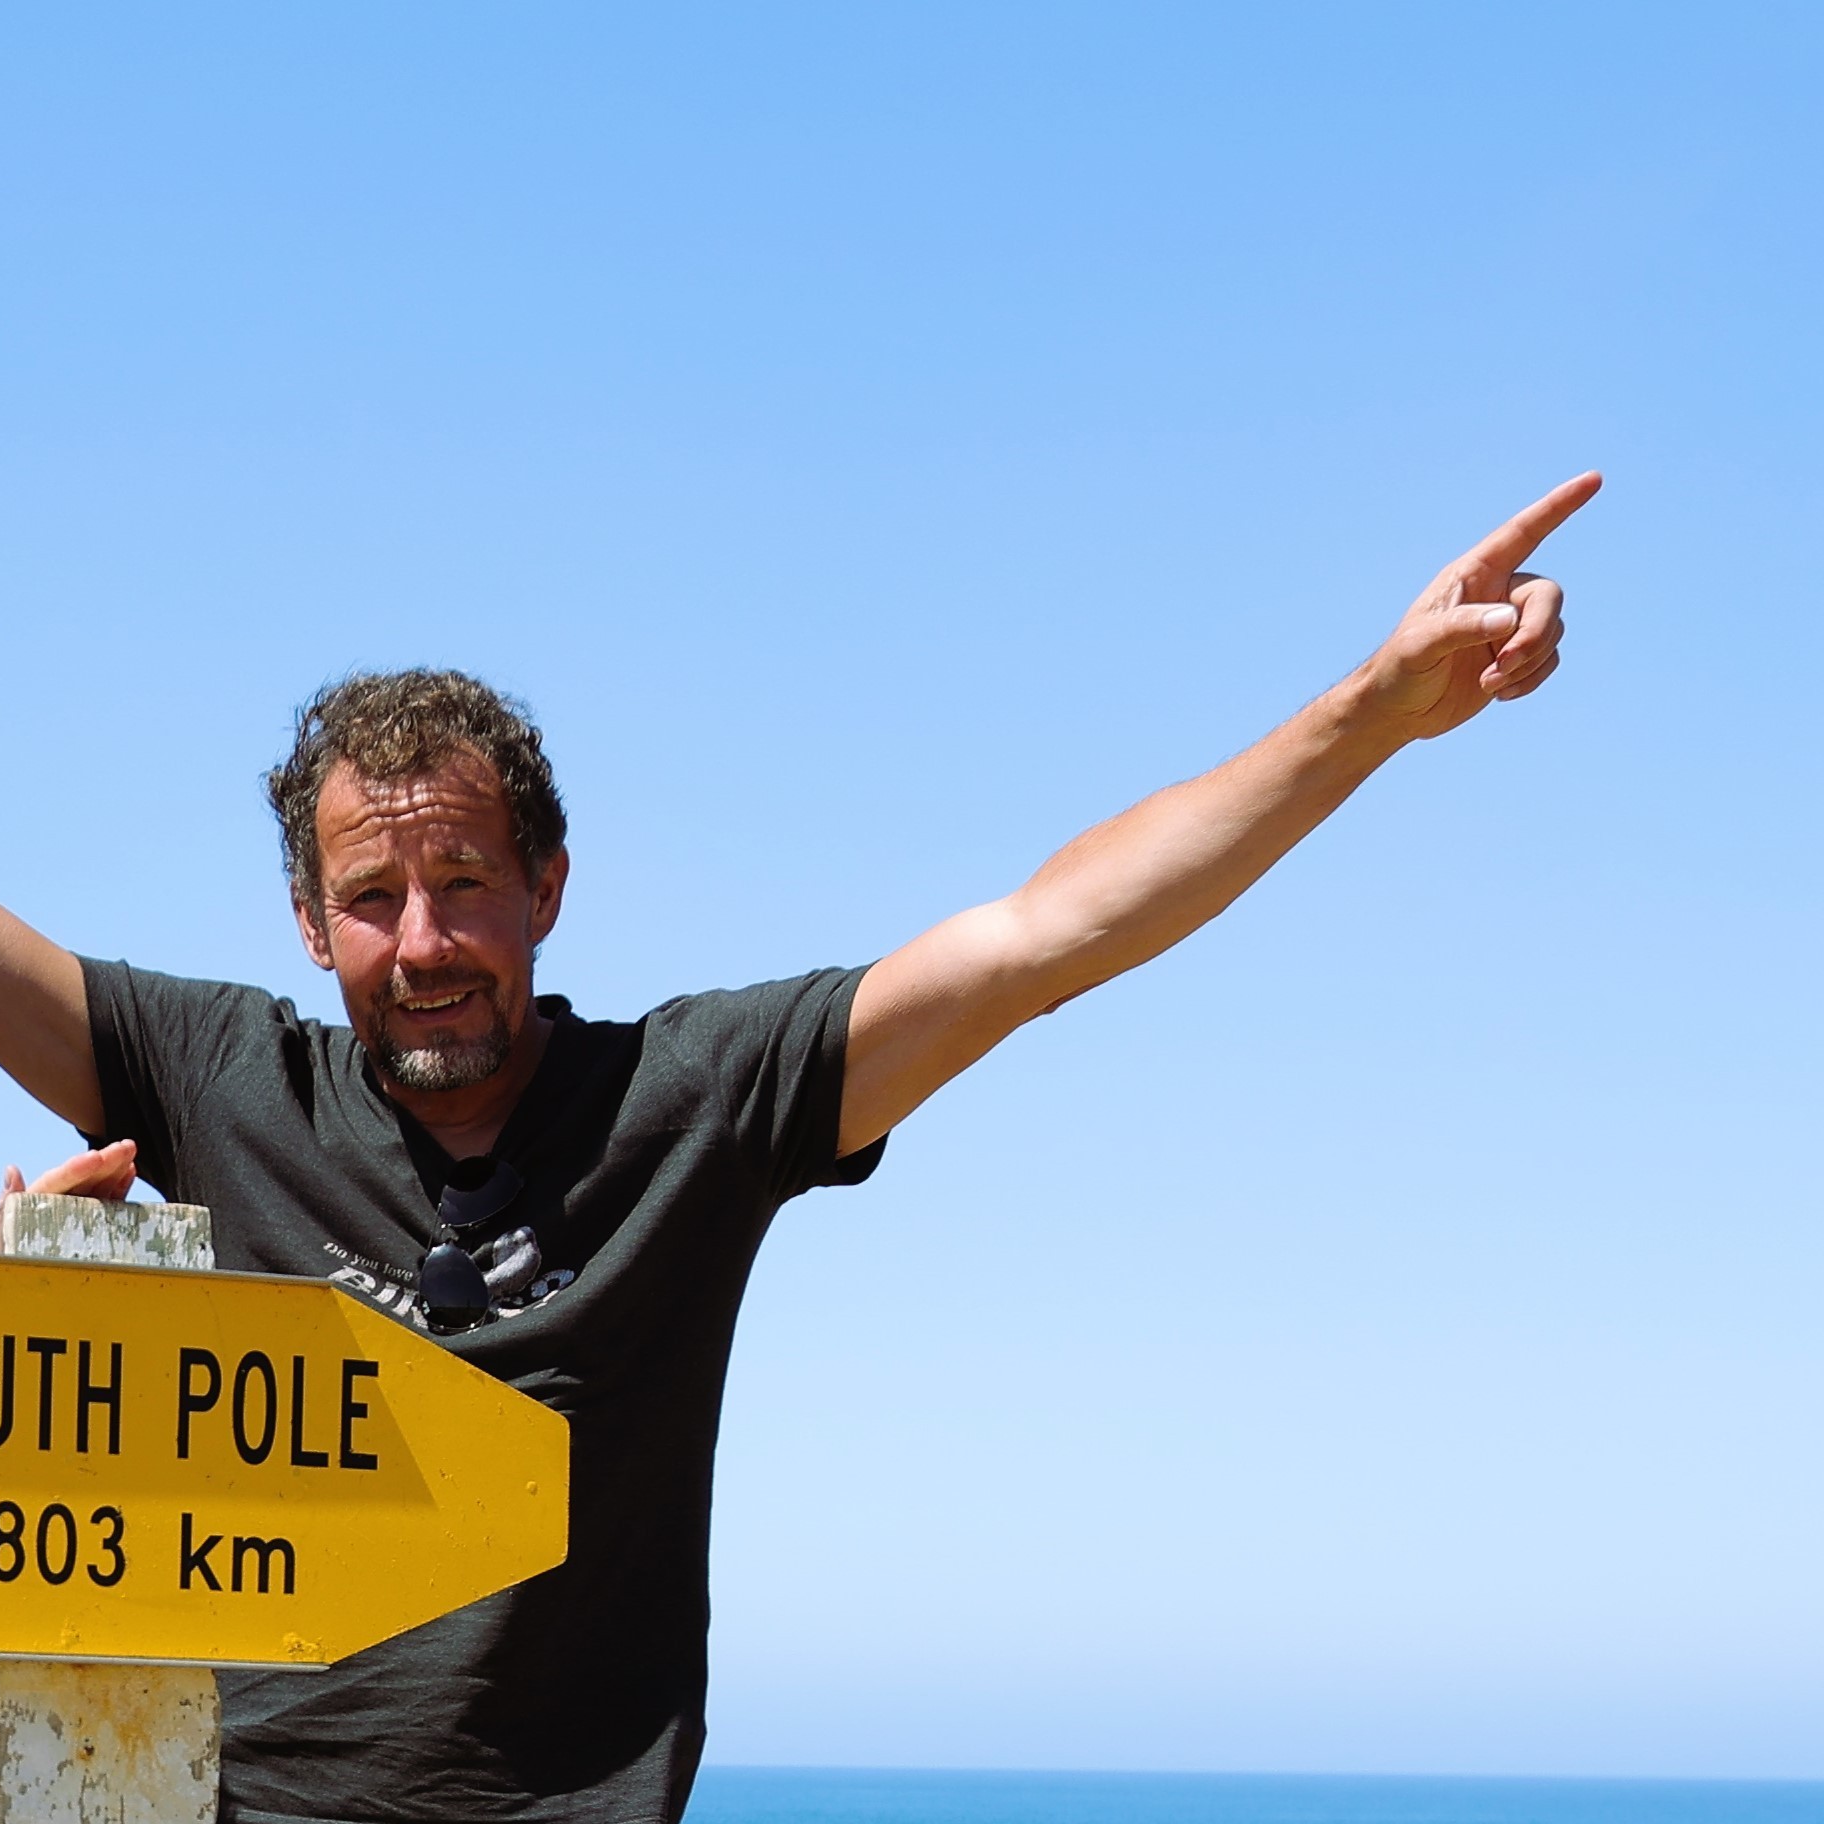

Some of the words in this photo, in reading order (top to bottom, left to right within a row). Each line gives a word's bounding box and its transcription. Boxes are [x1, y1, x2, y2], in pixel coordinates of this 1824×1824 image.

[350, 1253, 379, 1270] you
[383, 1263, 413, 1281] love
[176, 1347, 378, 1470] POLE
[180, 1513, 294, 1594] km
